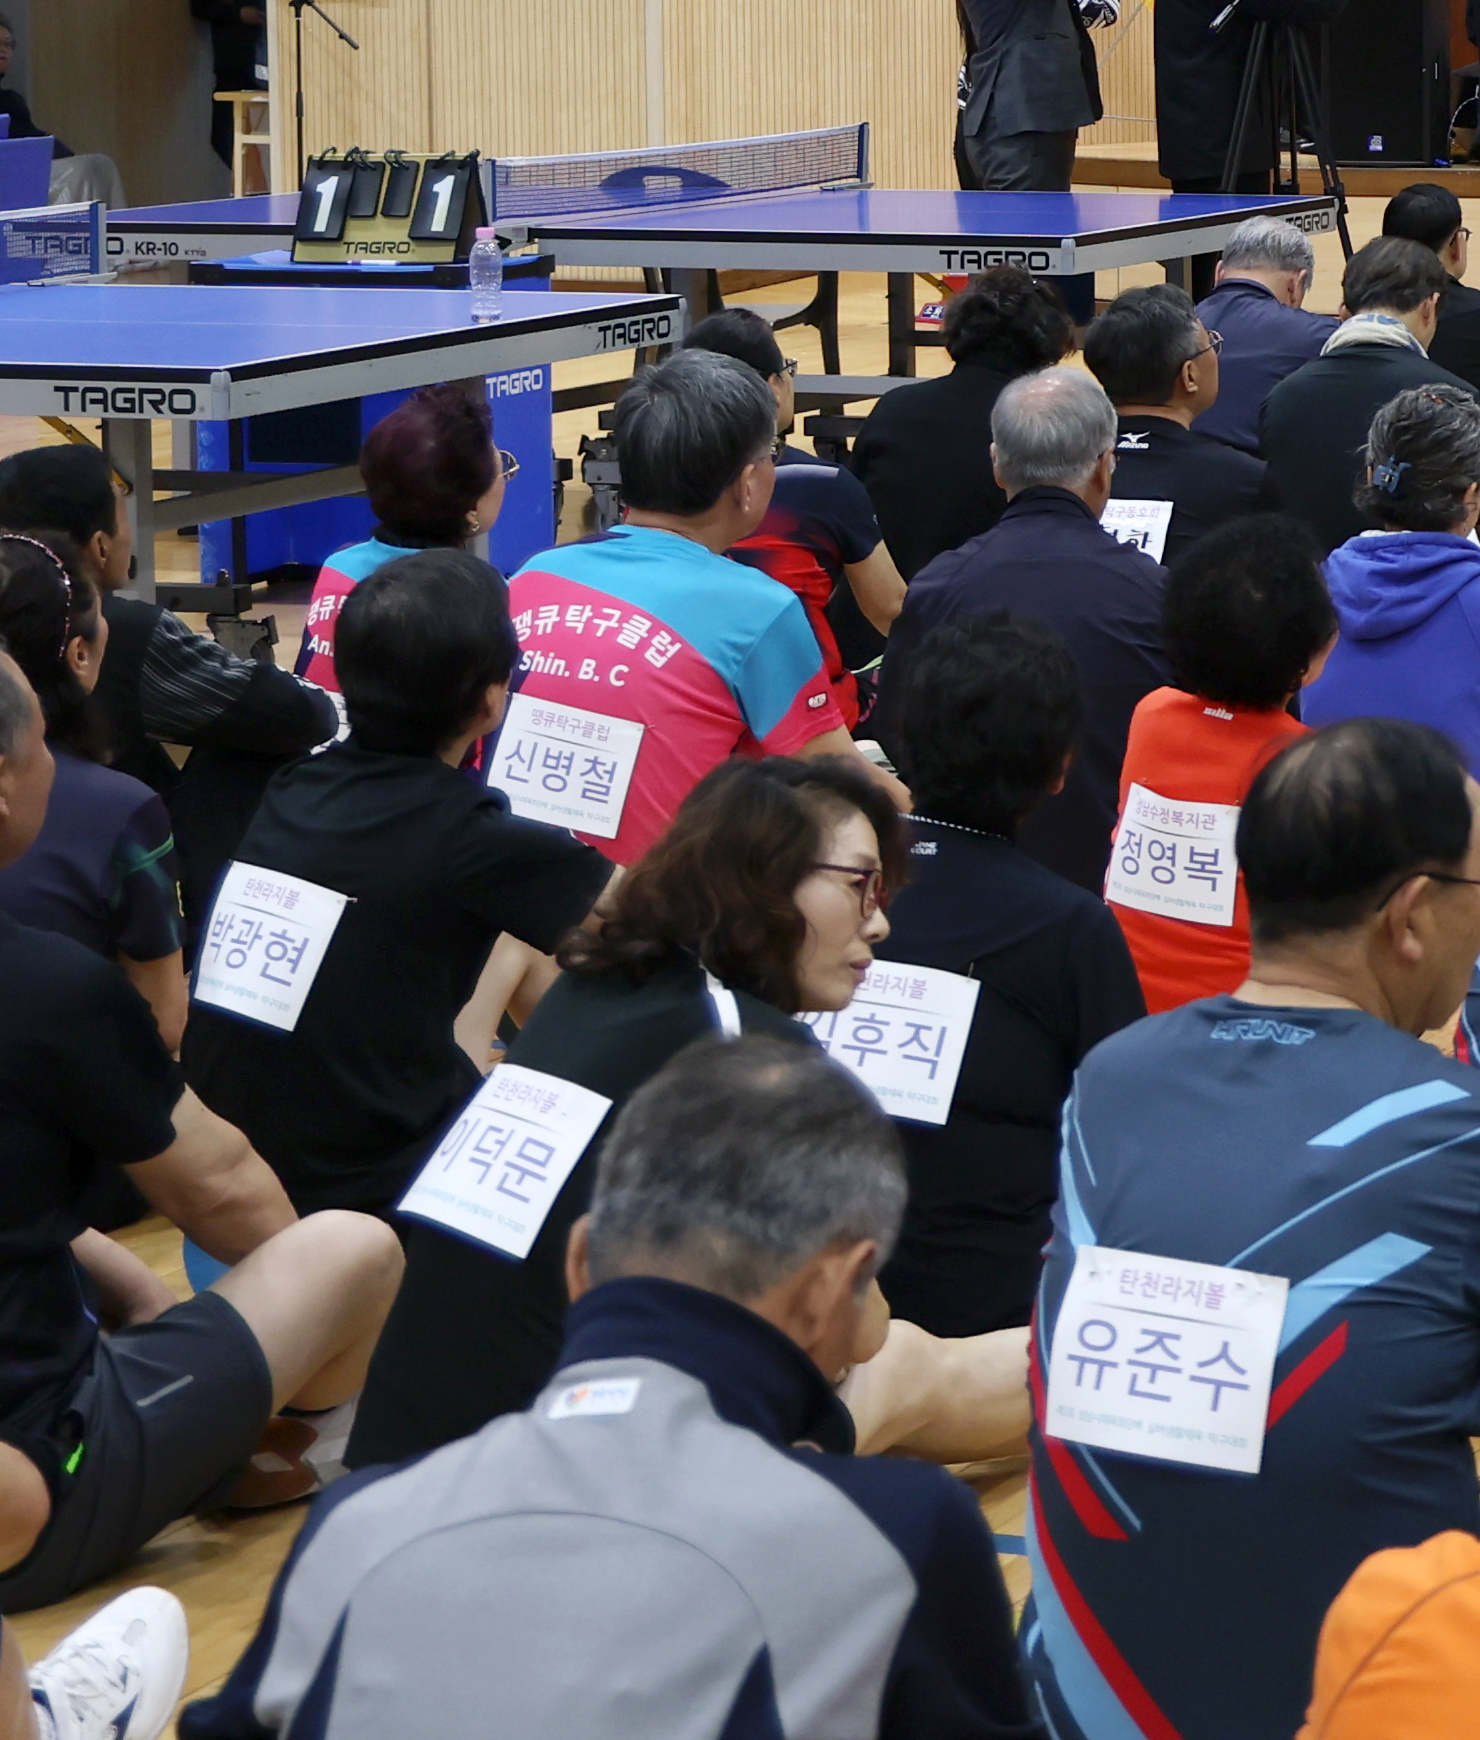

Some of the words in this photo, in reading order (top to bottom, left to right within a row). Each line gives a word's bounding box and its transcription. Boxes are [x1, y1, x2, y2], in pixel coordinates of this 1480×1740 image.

[314, 175, 338, 232] 1
[431, 174, 455, 232] 1
[25, 235, 124, 256] TAGO
[135, 241, 178, 256] KR-10
[343, 241, 411, 254] TAGRO
[598, 315, 670, 349] TAGRO
[53, 385, 196, 415] TAGRO
[486, 368, 543, 399] TAGRO
[512, 604, 682, 669] 땡큐탁구클럽
[519, 650, 570, 678] Shin.
[578, 659, 600, 681] B.
[609, 664, 630, 687] C
[531, 708, 611, 742] 땡큐탁구클럽
[505, 739, 618, 804] 신병철
[1135, 798, 1218, 831] 성남수정복지관
[1121, 829, 1223, 892] 정영복
[243, 878, 301, 910] 탄천라지볼
[209, 912, 310, 987] 박광현
[440, 1118, 556, 1204] 이덕문
[1119, 1268, 1225, 1310] 탄천라지볼
[1067, 1318, 1250, 1412] 유준수
